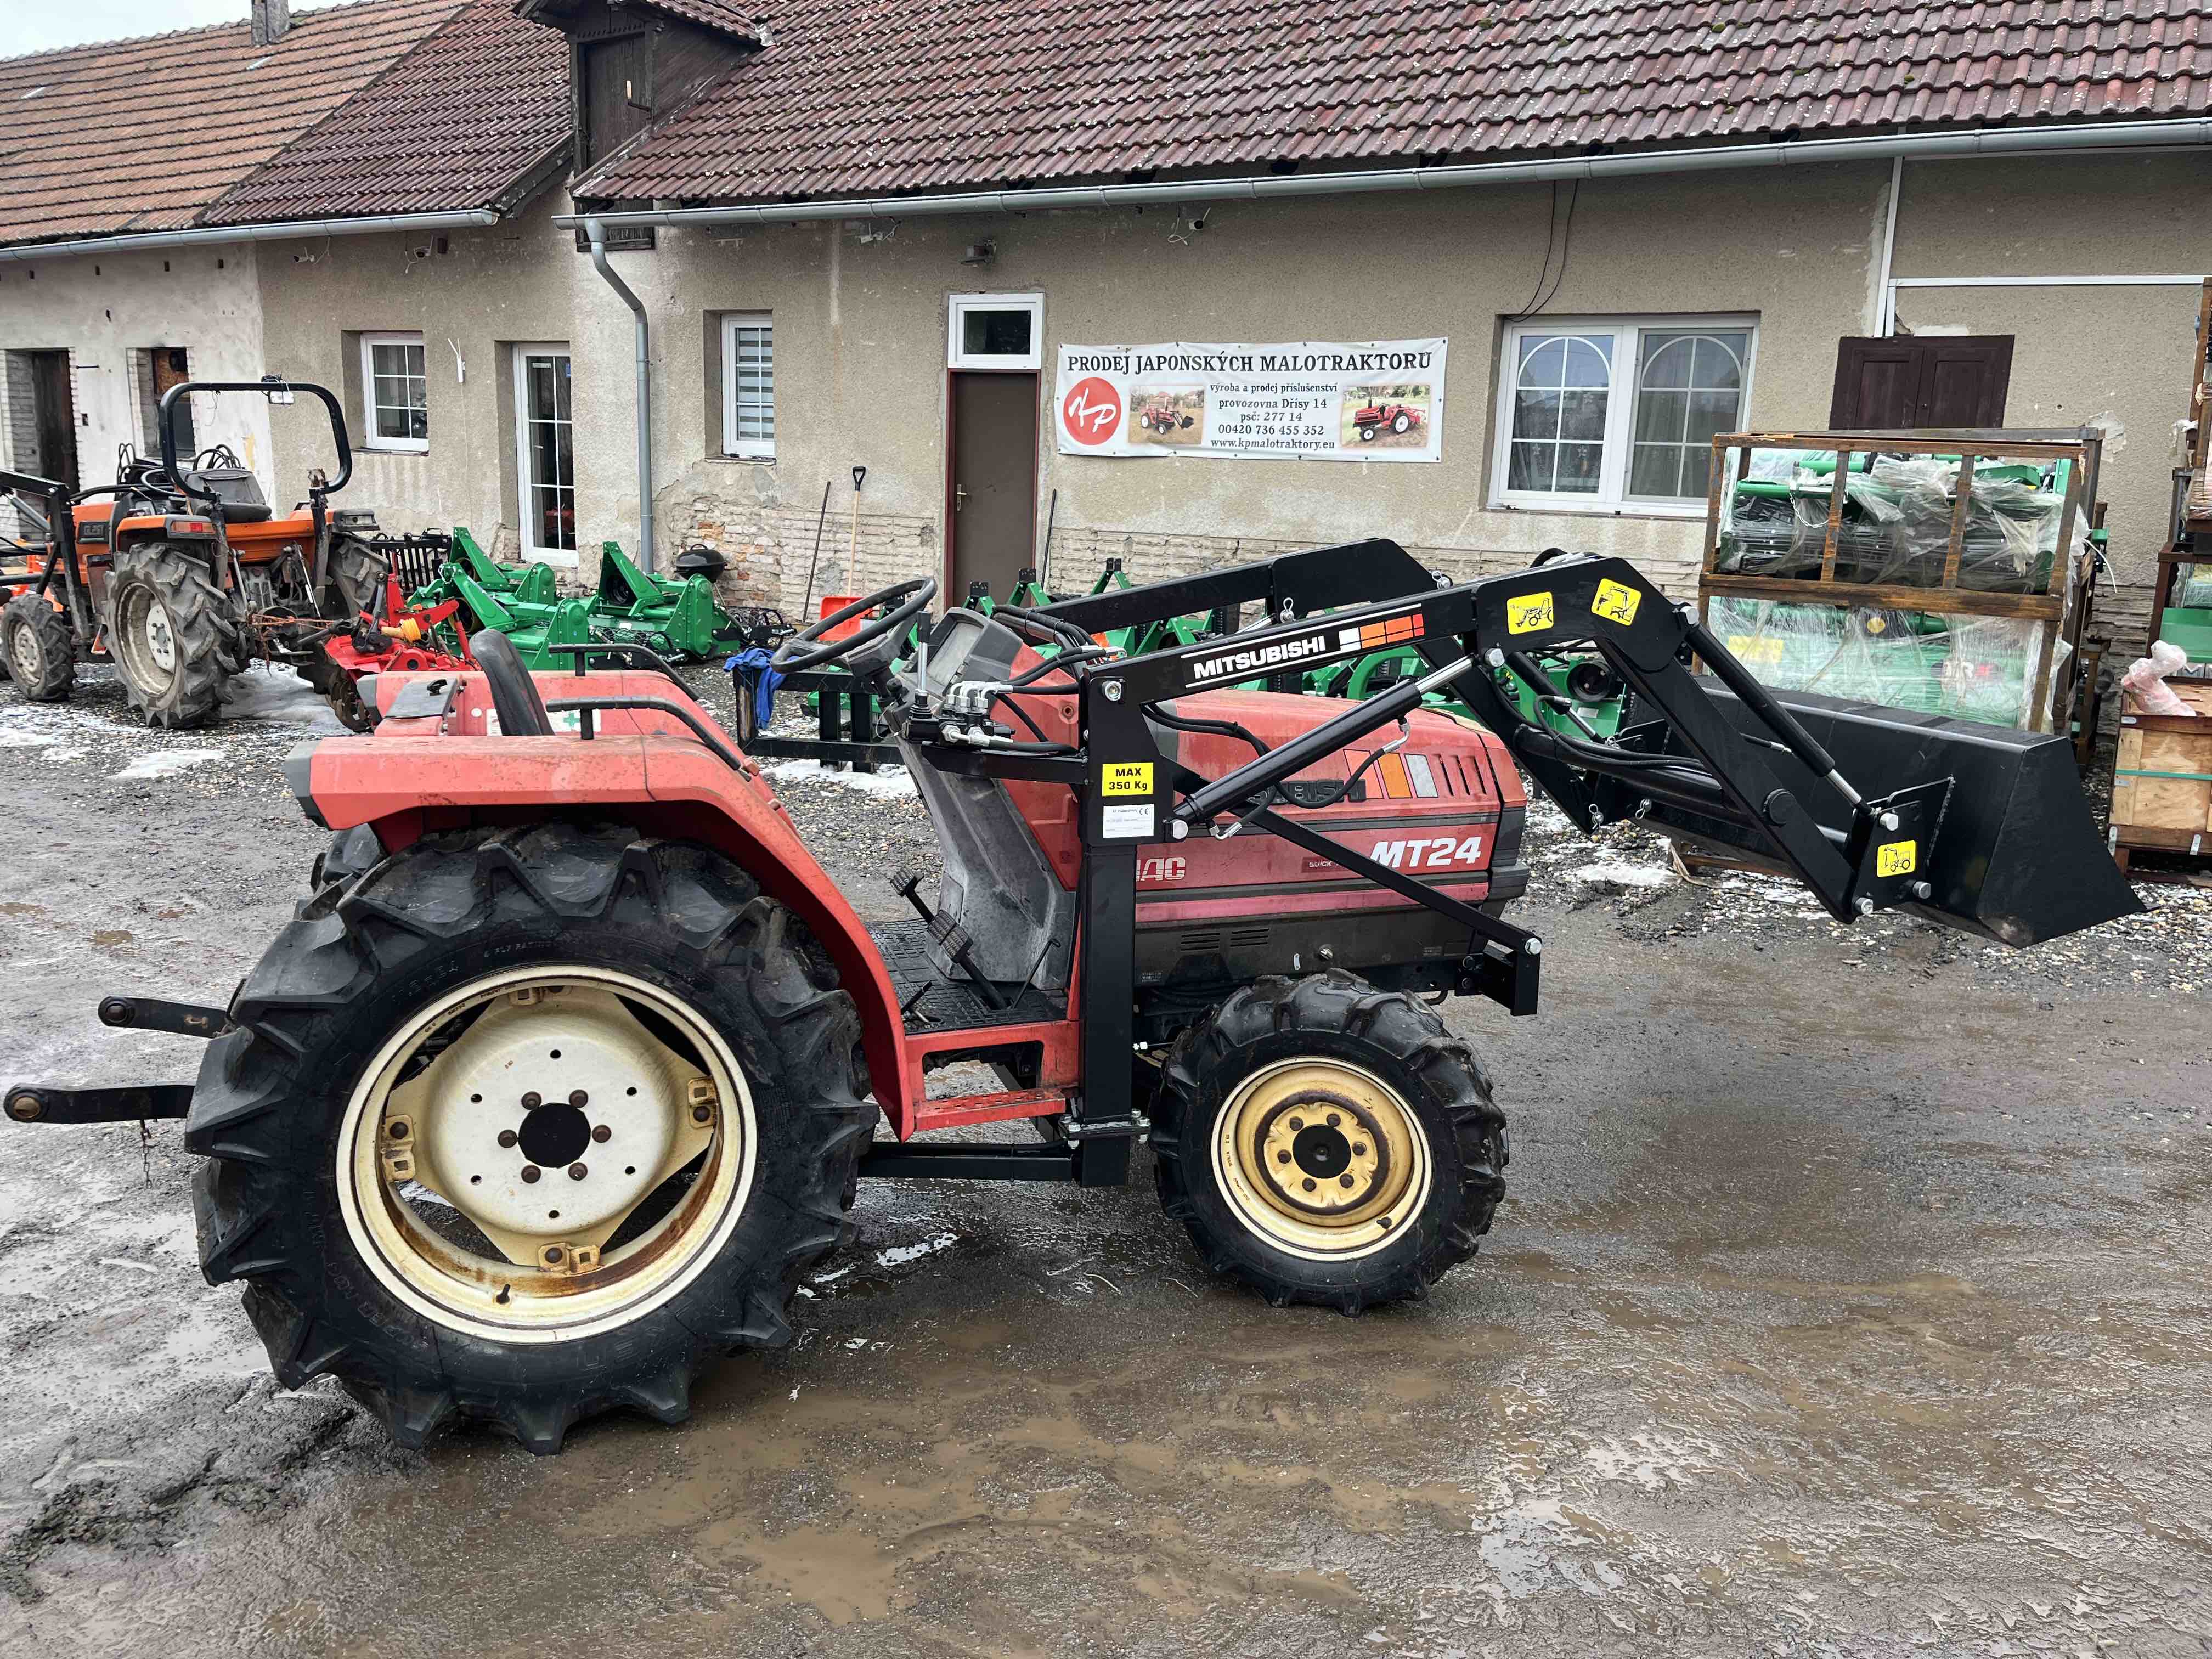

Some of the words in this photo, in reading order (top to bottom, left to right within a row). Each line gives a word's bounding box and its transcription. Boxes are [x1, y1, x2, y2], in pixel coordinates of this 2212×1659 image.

[1068, 356, 1130, 374] PRODEJ
[1135, 351, 1254, 374] JAPONSKÝCH
[1210, 383, 1239, 393] výroba
[1251, 383, 1278, 394] prodej
[1281, 383, 1338, 394] příslušenství
[1219, 400, 1278, 409] provozovna
[1282, 398, 1310, 410] Dřísy
[1314, 398, 1327, 408] 14
[1240, 412, 1259, 423] psč:
[1263, 412, 1285, 421] 277
[1289, 412, 1302, 421] 14
[1218, 425, 1251, 434] 00420
[1255, 425, 1275, 435] 736
[1279, 425, 1299, 435] 455
[1304, 426, 1324, 435] 352
[1211, 438, 1334, 450] www.kpmalotraktory.eu
[1193, 635, 1325, 679] MITSUBISHI
[1115, 768, 1142, 777] MAX
[1109, 781, 1131, 790] 350
[1134, 781, 1148, 791] Kg
[1370, 836, 1482, 868] MT24
